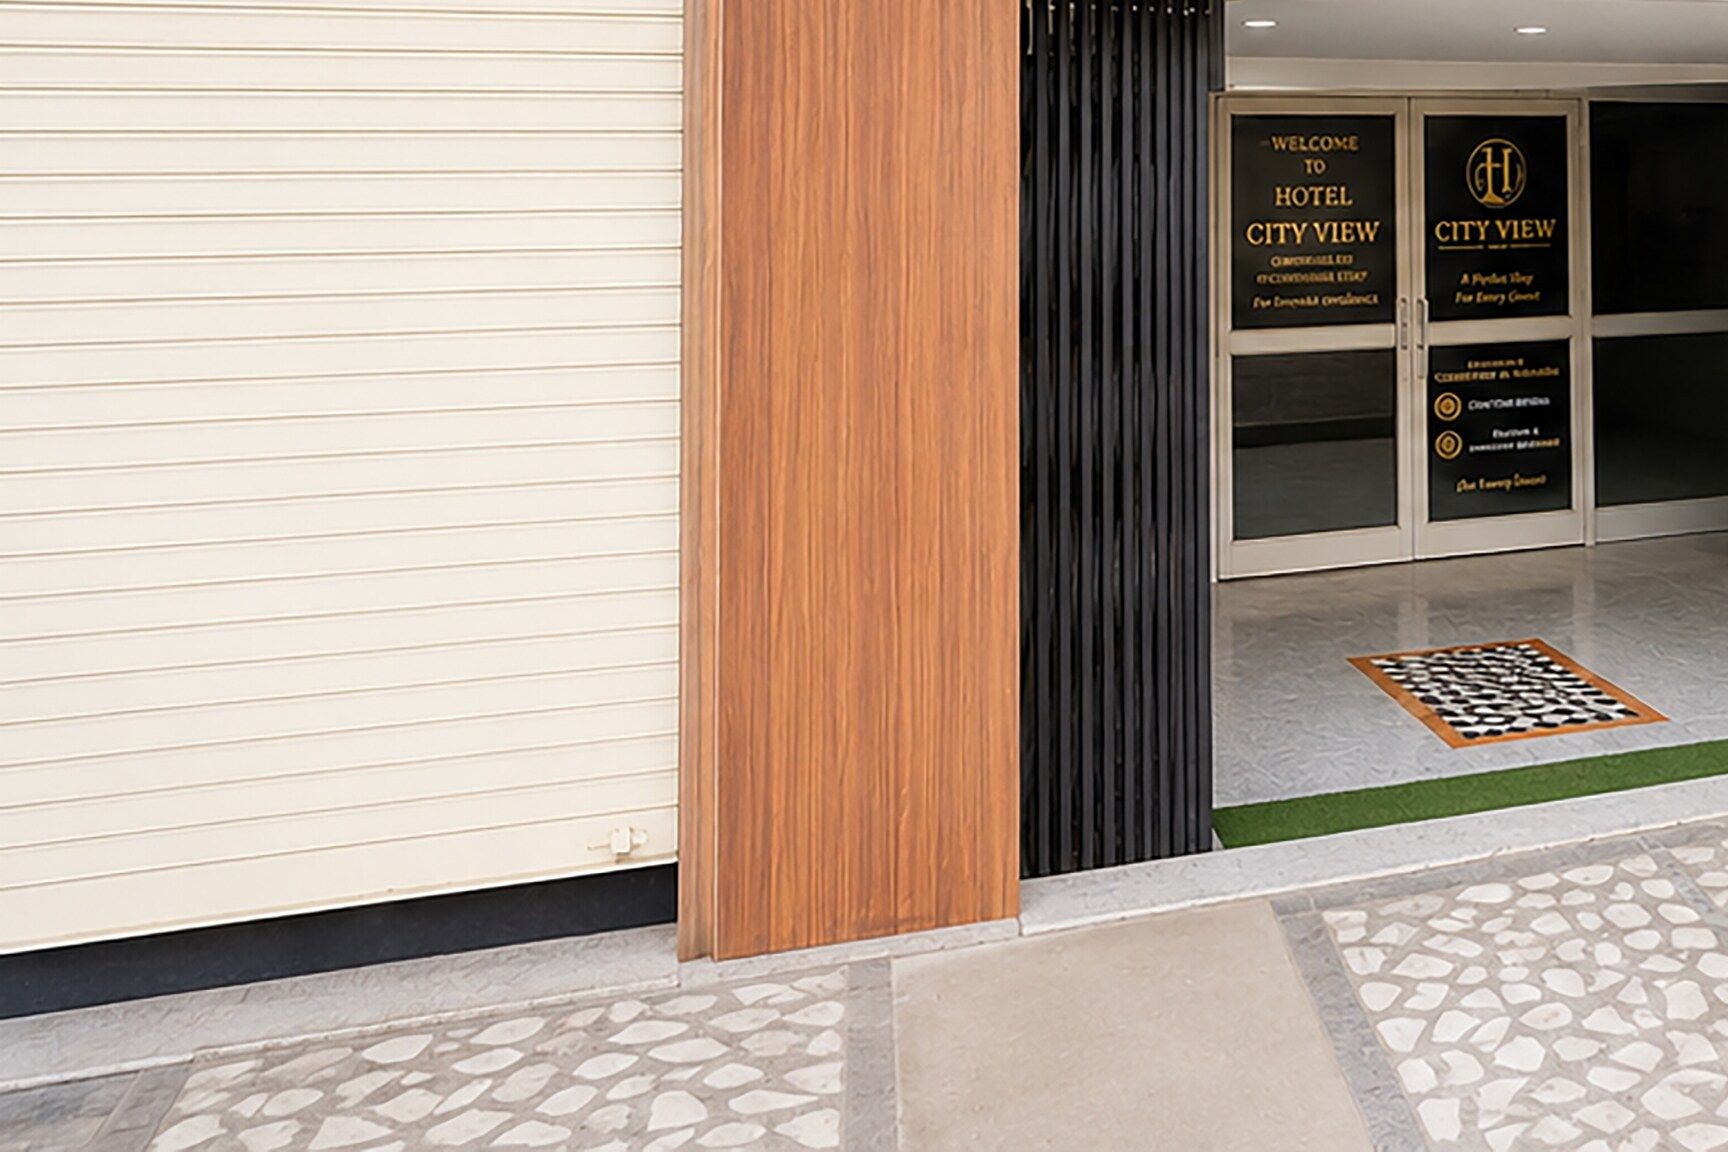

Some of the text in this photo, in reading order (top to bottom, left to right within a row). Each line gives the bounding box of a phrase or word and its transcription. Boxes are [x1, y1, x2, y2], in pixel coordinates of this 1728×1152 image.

[1271, 135, 1359, 151] WELCOME
[1304, 158, 1326, 174] TO
[1275, 185, 1353, 207] HOTEL
[1246, 221, 1380, 245] CITY VIEW
[1434, 218, 1556, 242] CITY VIEW
